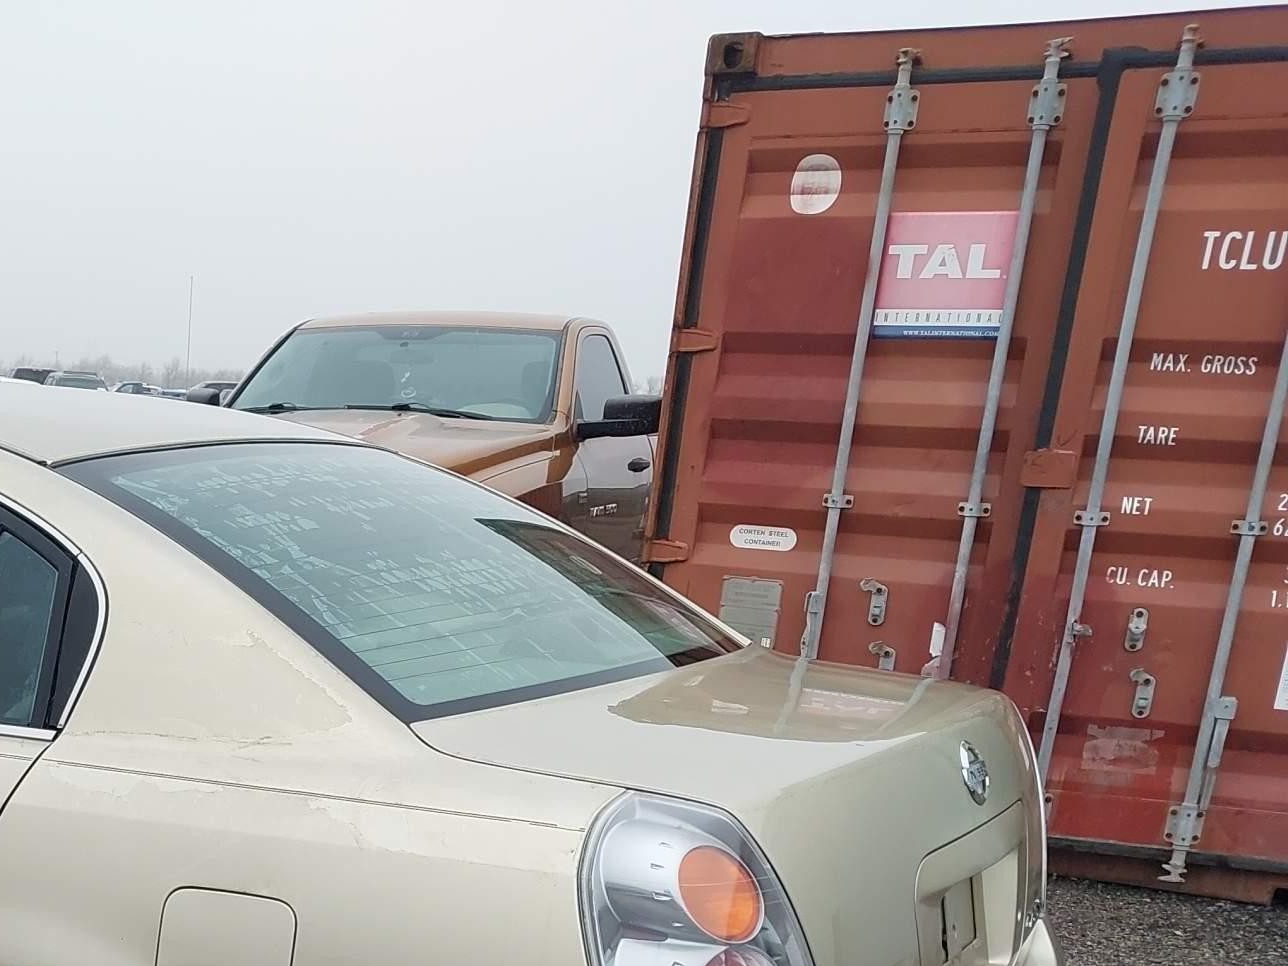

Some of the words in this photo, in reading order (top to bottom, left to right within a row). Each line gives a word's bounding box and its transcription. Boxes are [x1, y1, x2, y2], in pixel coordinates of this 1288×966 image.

[888, 243, 1001, 279] TAL
[1201, 230, 1288, 271] TCLU
[1150, 352, 1192, 373] MAX.
[1200, 354, 1259, 376] GROSS
[1137, 425, 1180, 446] TARE
[1120, 496, 1153, 516] NET
[743, 538, 781, 547] CONTAINER
[768, 530, 790, 538] STEEL
[1105, 566, 1131, 586] CU.
[1137, 567, 1175, 590] CAP.
